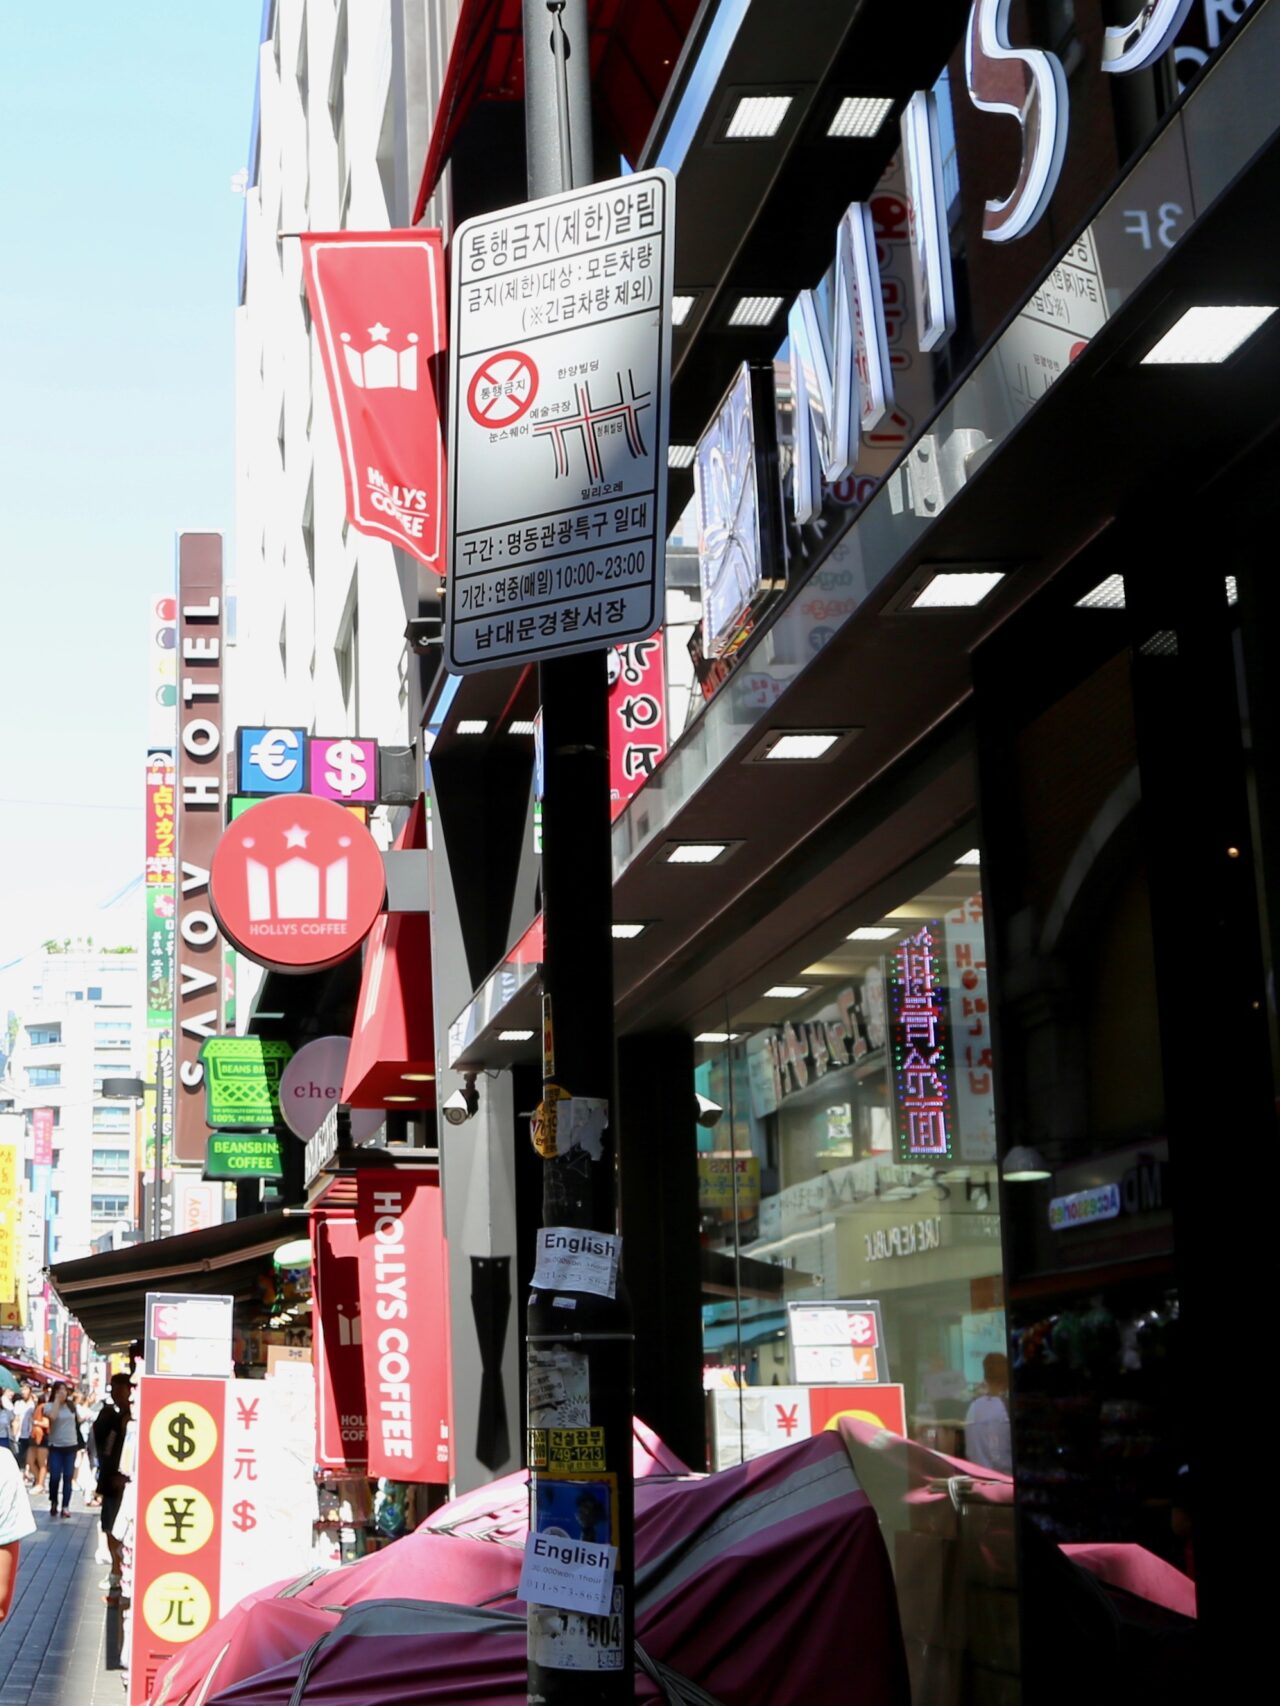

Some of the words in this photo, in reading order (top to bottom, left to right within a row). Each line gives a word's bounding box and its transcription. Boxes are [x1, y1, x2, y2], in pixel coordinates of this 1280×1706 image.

[468, 187, 656, 273] 통행금지(제한)알림
[588, 243, 653, 281] 모든차량
[614, 275, 654, 306] 제외)
[558, 360, 599, 380] 한양빌딩
[480, 379, 526, 400] 통행금지
[530, 400, 571, 420] 예술극장
[581, 481, 624, 500] 밀리오레
[507, 512, 609, 557] 명동관광특구
[613, 503, 647, 532] 일대
[494, 568, 554, 606] 연중(매일)
[556, 549, 645, 591] 10:00~23:00
[474, 597, 627, 650] 남대문경찰서장
[182, 596, 220, 804] HOTEL
[324, 739, 367, 797] $
[249, 922, 298, 936] HOLLYS
[301, 922, 348, 936] COFFEE
[227, 1157, 274, 1169] COFFEE
[372, 1190, 409, 1321] HOLLYS
[545, 1233, 616, 1258] English
[377, 1327, 414, 1459] COFFEE
[236, 1397, 259, 1431] ¥
[341, 1415, 367, 1426] HOL
[167, 1412, 197, 1463] $
[341, 1430, 368, 1441] COF
[552, 1430, 602, 1446] 건설잡부
[233, 1449, 259, 1482] 元
[551, 1447, 603, 1462] 749-1213
[163, 1497, 195, 1544] ¥
[231, 1499, 258, 1533] $
[534, 1539, 610, 1569] English
[160, 1586, 195, 1627] 元
